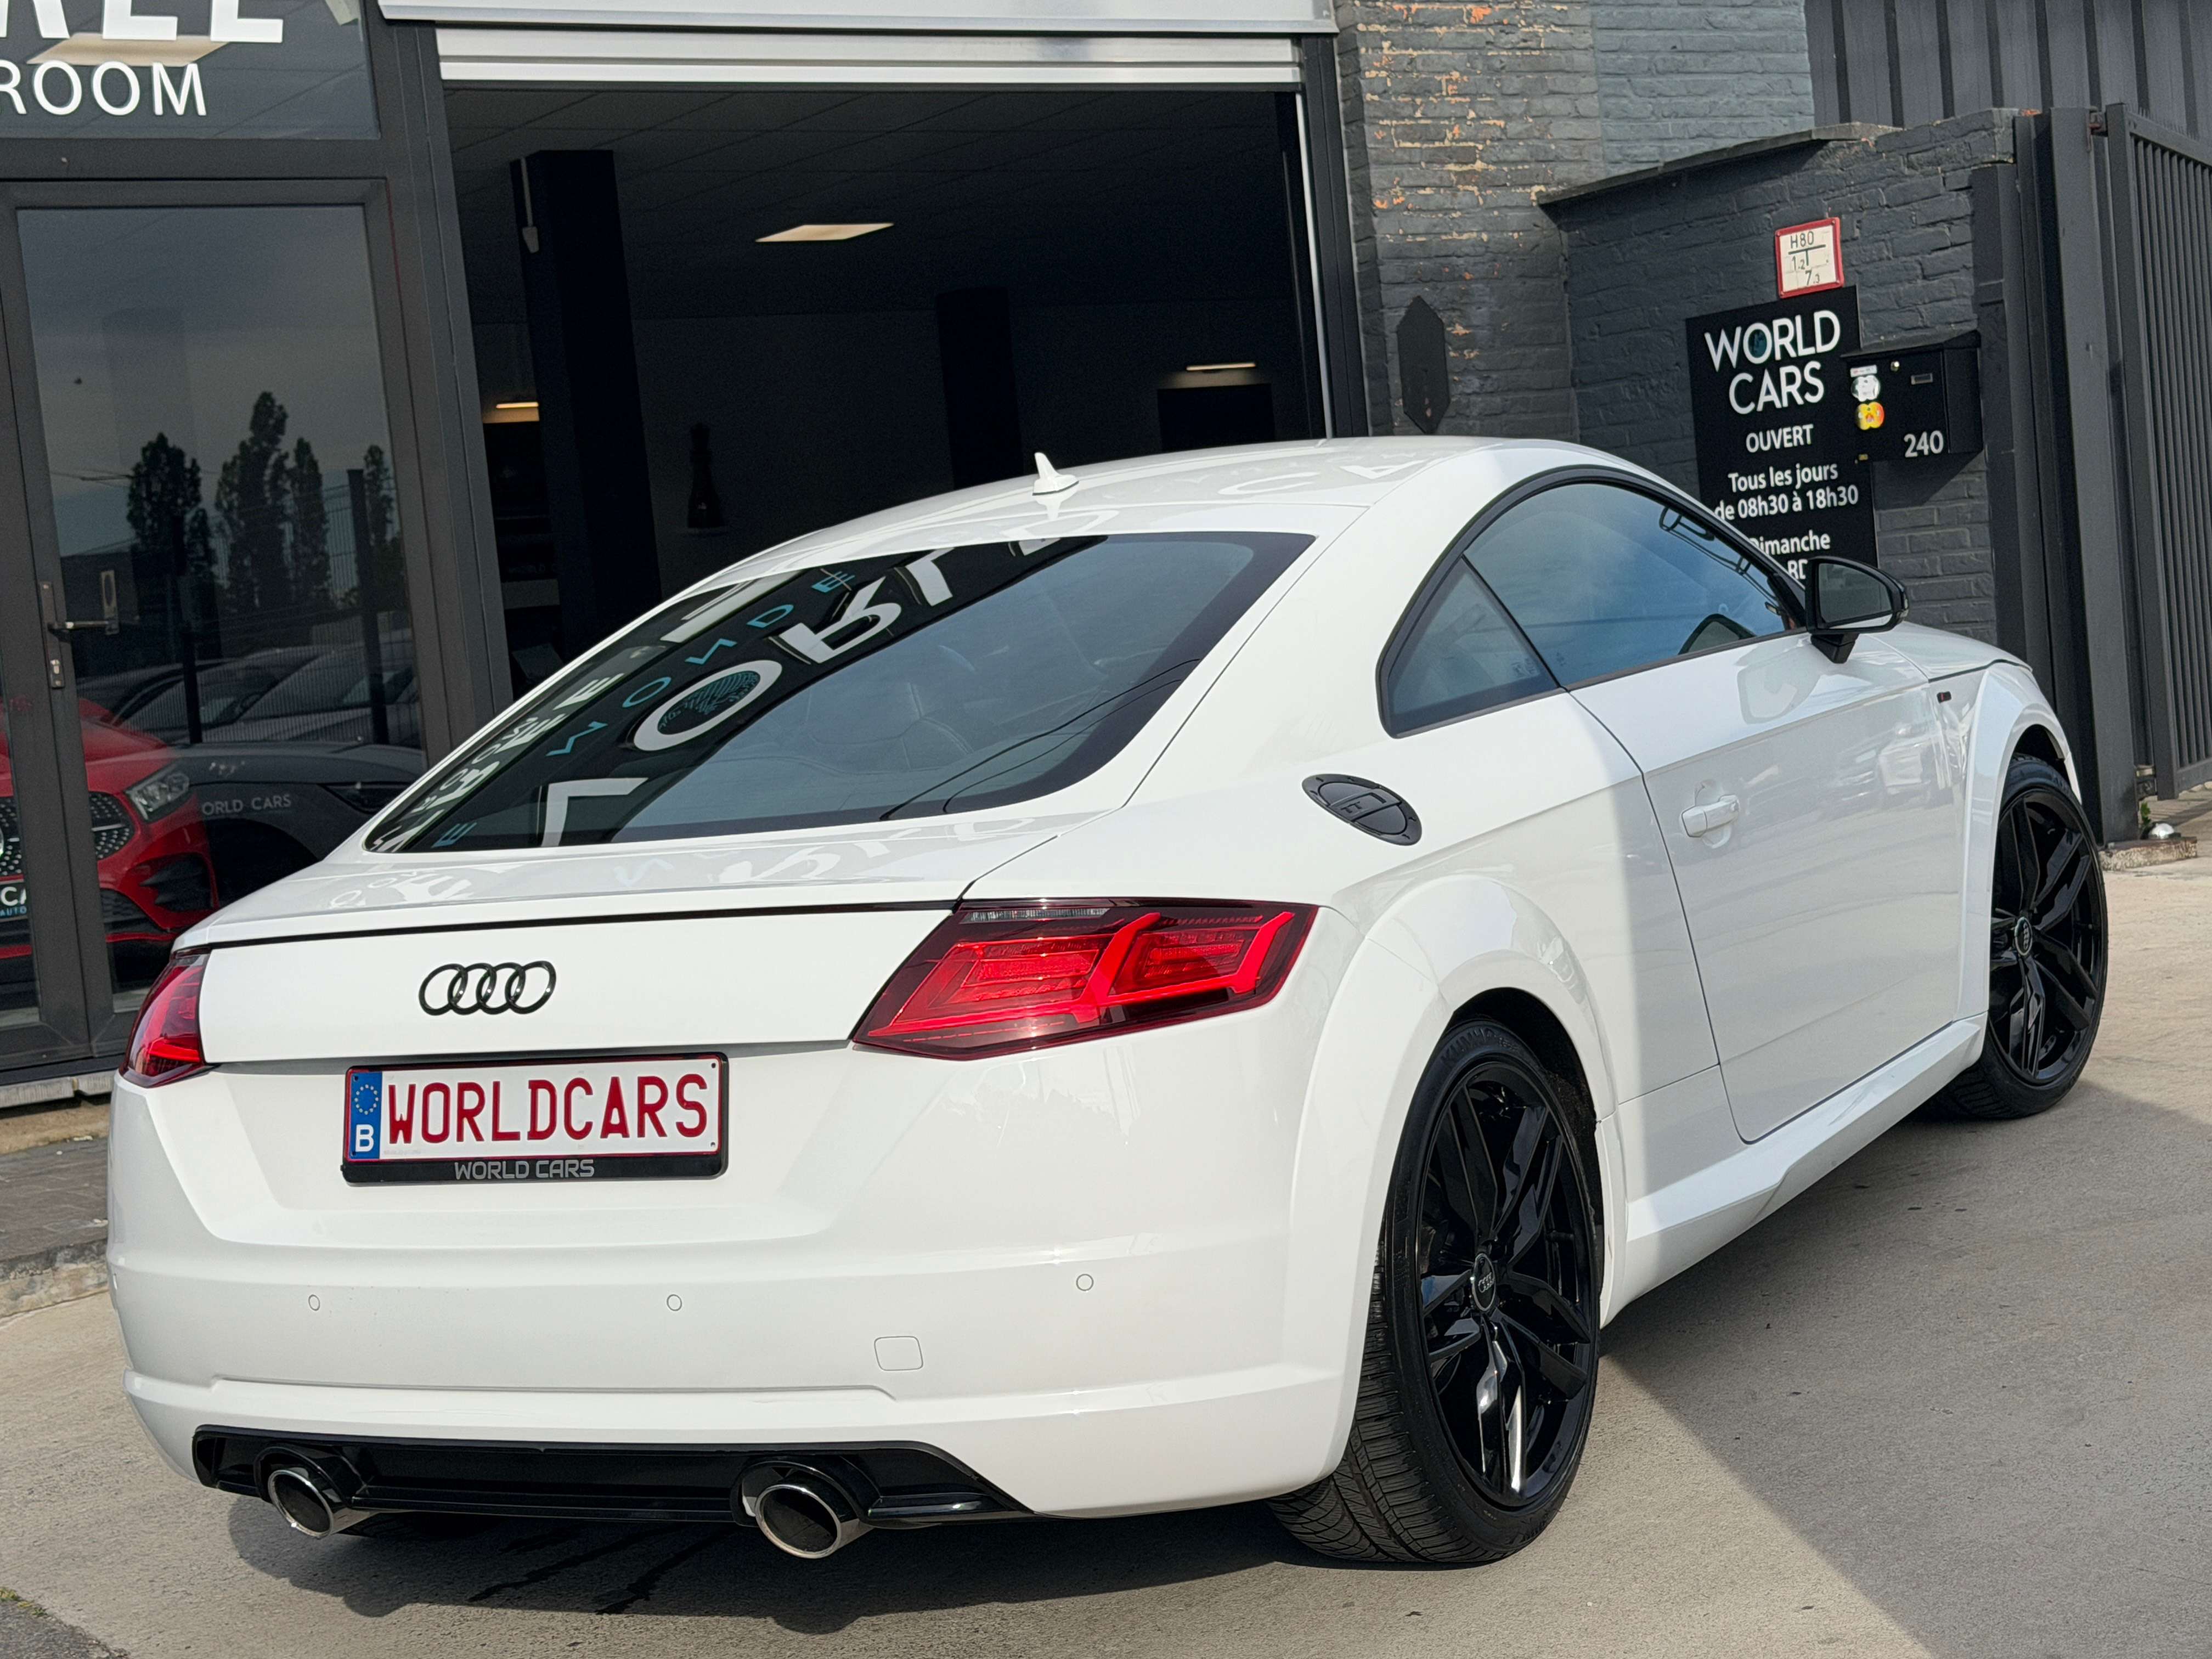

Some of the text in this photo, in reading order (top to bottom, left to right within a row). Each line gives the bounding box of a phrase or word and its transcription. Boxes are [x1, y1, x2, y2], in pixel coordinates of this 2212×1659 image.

[1790, 230, 1814, 249] H80
[1704, 310, 1841, 373] WORLD
[1729, 360, 1824, 414] CARS
[1746, 424, 1814, 453] OUVERT
[1904, 430, 1943, 458] 240
[1728, 463, 1838, 492] Tous les jours
[1714, 484, 1858, 520] de 08h30 à 18h30
[202, 794, 291, 816] ORLD CARS
[388, 1074, 707, 1144] WORLDCARS
[355, 1125, 374, 1152] B
[454, 1159, 595, 1180] WORLD CARS
